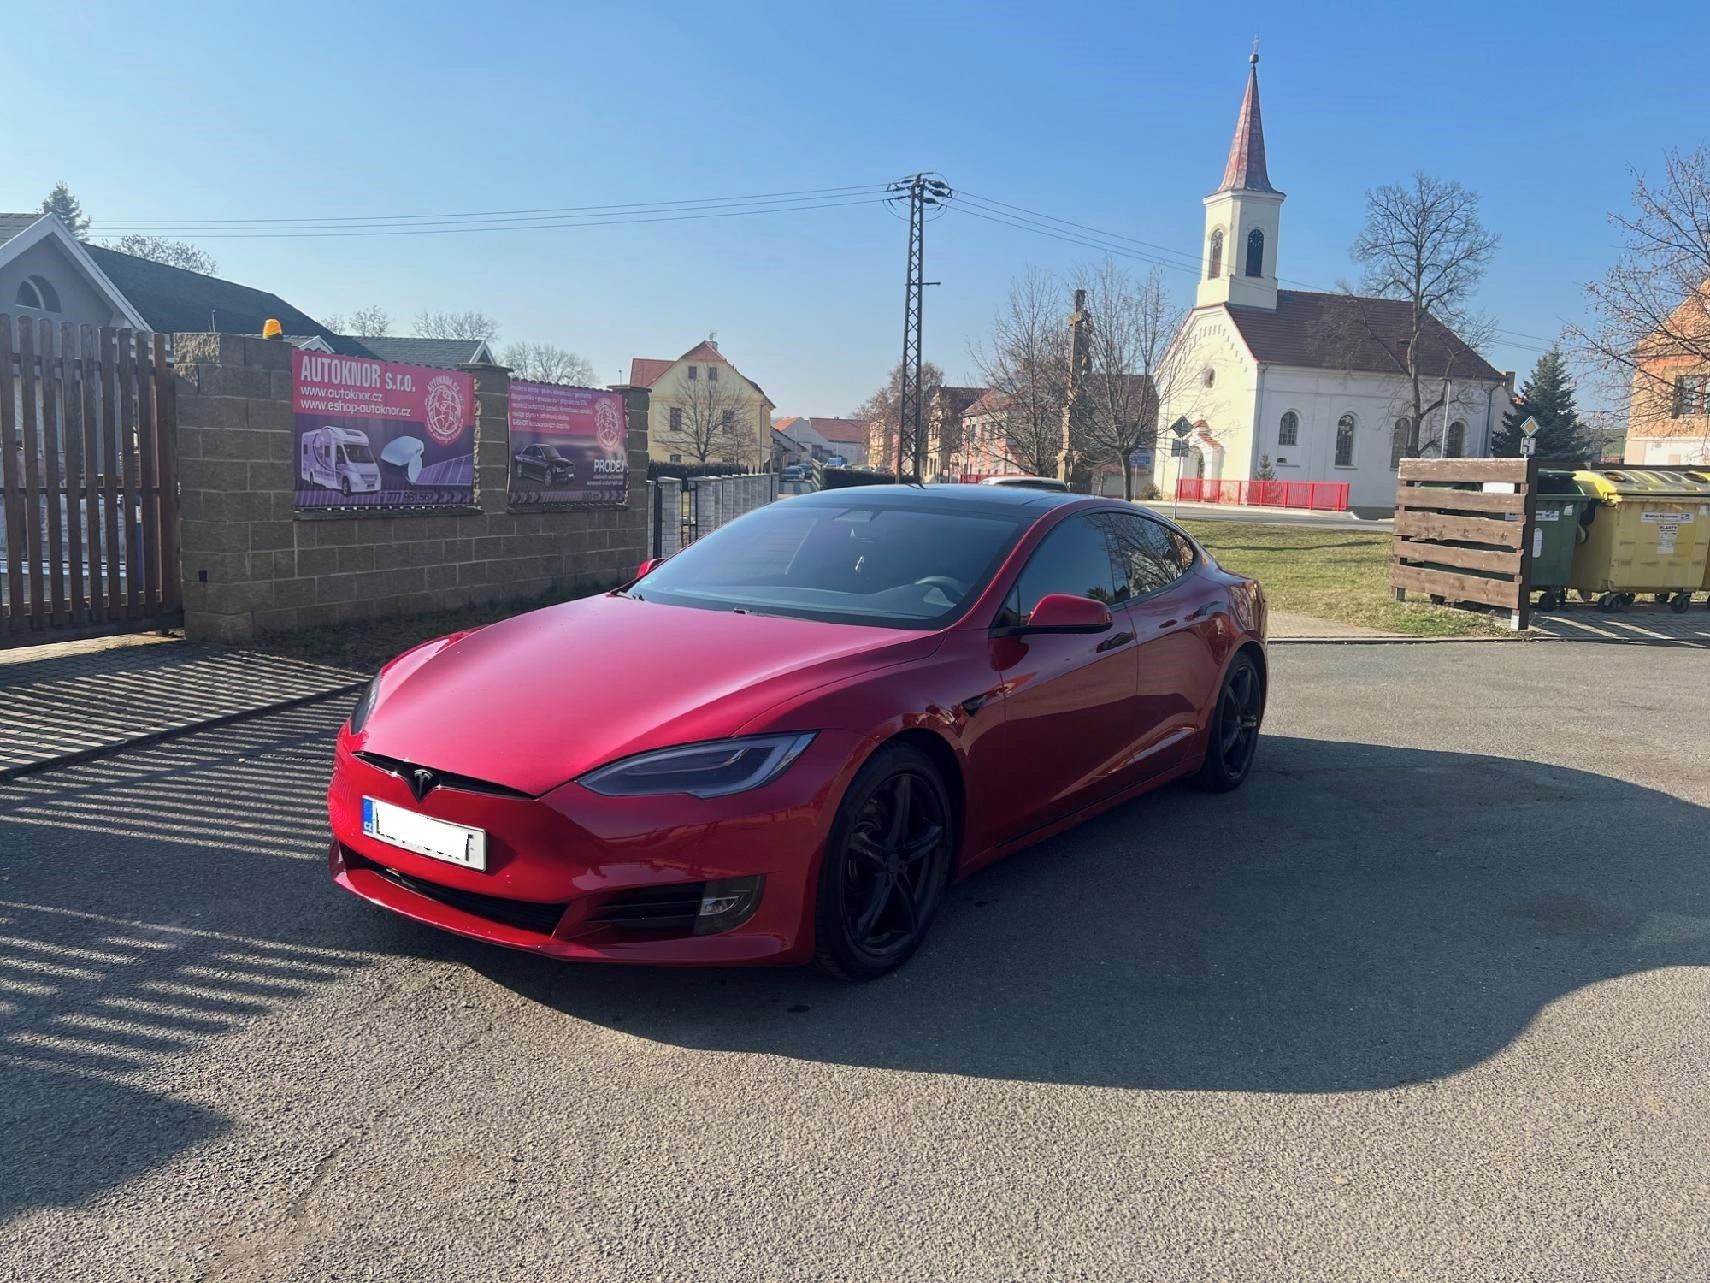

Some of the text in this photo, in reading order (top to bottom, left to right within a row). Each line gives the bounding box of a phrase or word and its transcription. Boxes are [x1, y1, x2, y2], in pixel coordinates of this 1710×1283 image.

[301, 356, 416, 392] AUTOKNOR s.r.o.
[301, 387, 383, 402] www.autoknor.cz
[301, 400, 411, 417] www.eshop-autoknor.cz
[593, 459, 625, 473] PRODEJ
